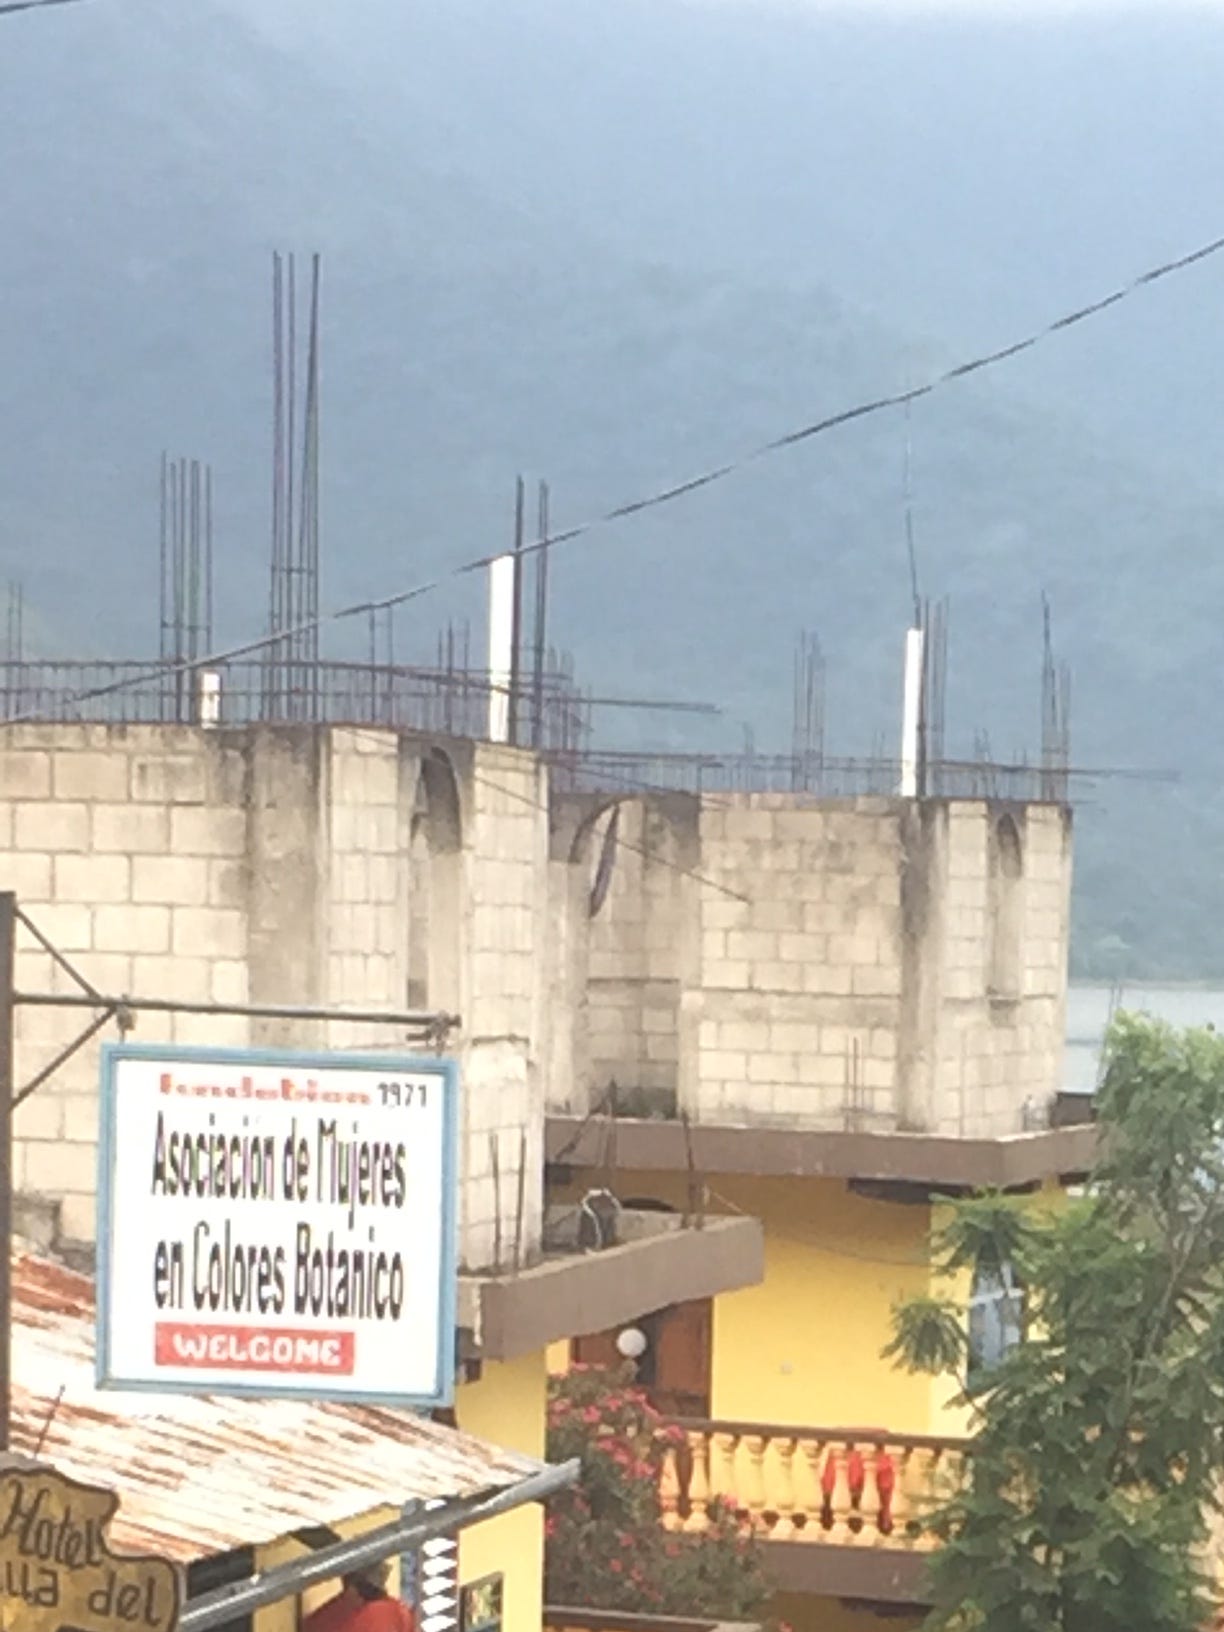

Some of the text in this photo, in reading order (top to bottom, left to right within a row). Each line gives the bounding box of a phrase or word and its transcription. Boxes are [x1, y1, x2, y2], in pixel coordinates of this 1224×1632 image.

[376, 1081, 428, 1108] 1971
[283, 1117, 310, 1202] de
[316, 1117, 407, 1230] Mujeres
[153, 1218, 404, 1322] en Colores Botanico
[0, 1479, 103, 1570] Hotel
[88, 1569, 161, 1627] del
